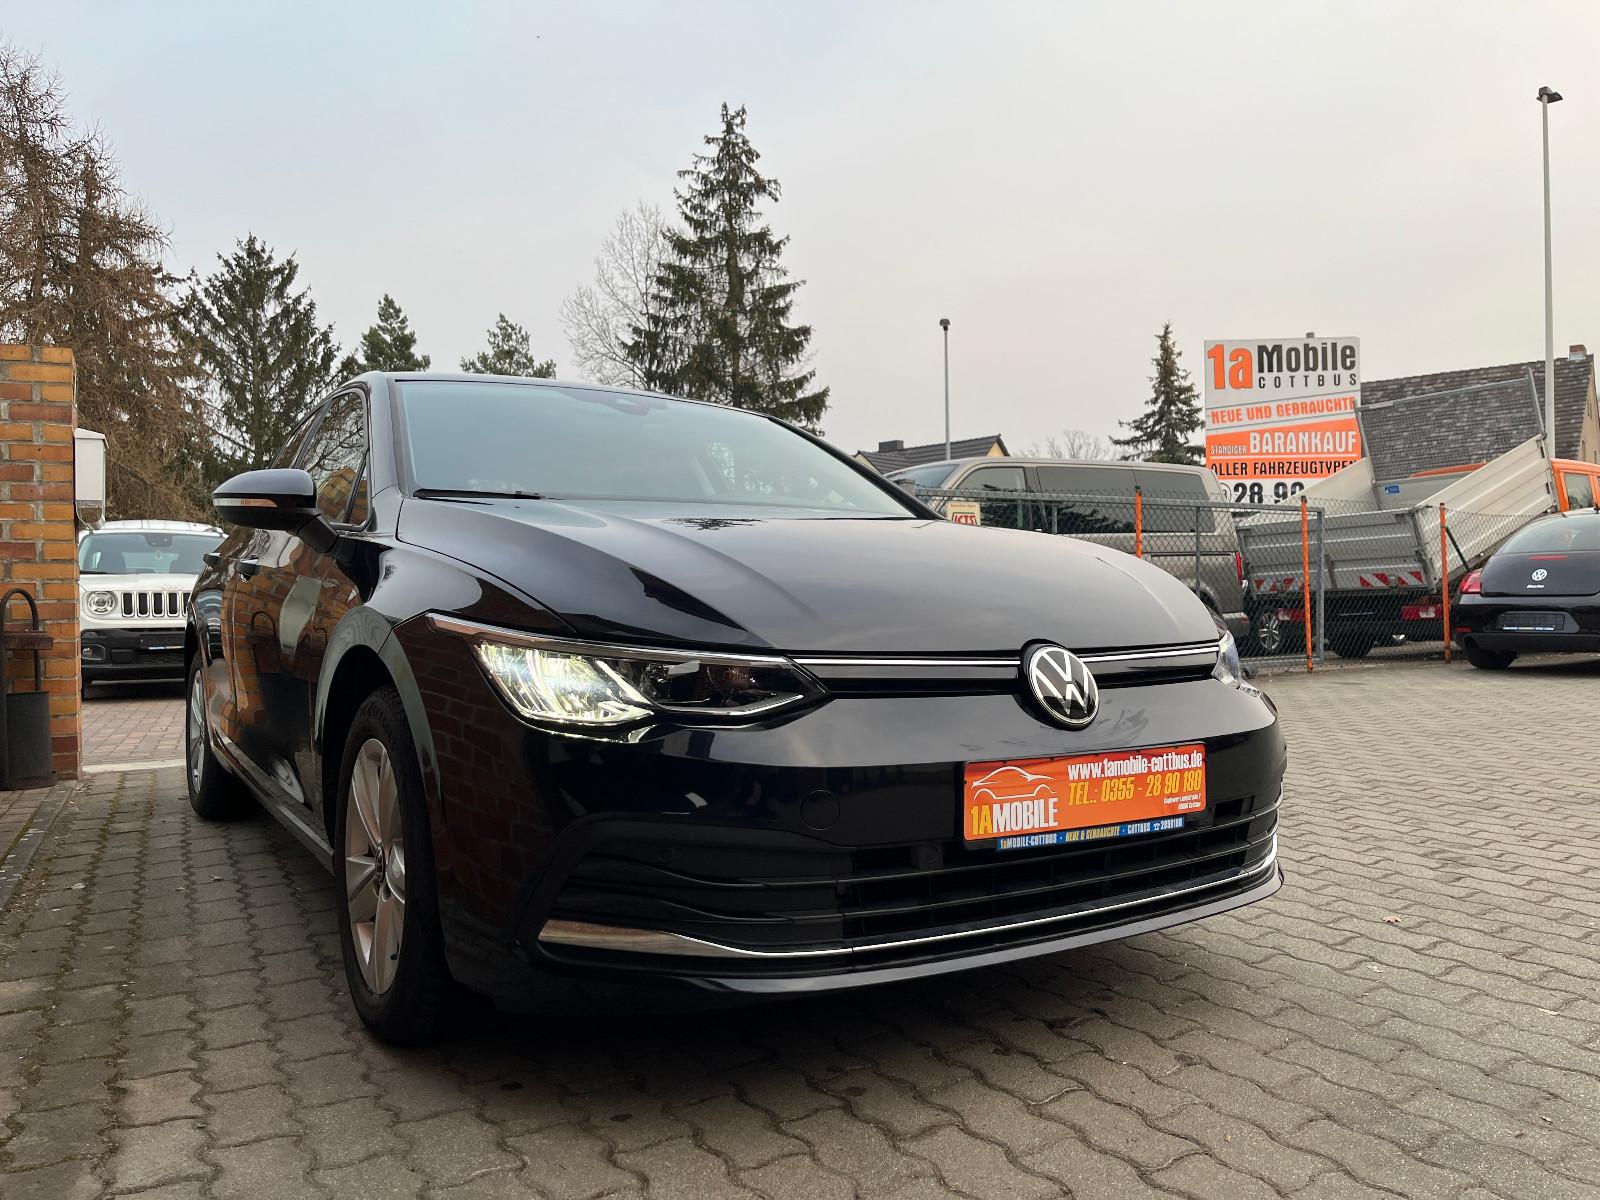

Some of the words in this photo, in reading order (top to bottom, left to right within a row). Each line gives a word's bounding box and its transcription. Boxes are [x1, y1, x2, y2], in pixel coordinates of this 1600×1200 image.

[1257, 342, 1356, 373] Mobile
[1258, 373, 1357, 389] COTTBUS
[1211, 408, 1243, 424] NEUE
[1246, 406, 1272, 420] UND
[1250, 431, 1357, 454] BARANKAUF
[1067, 750, 1203, 780] www.1amobile-cottbus.de
[1101, 777, 1135, 802] 0355
[1145, 774, 1162, 797] 28
[1164, 772, 1180, 795] 90
